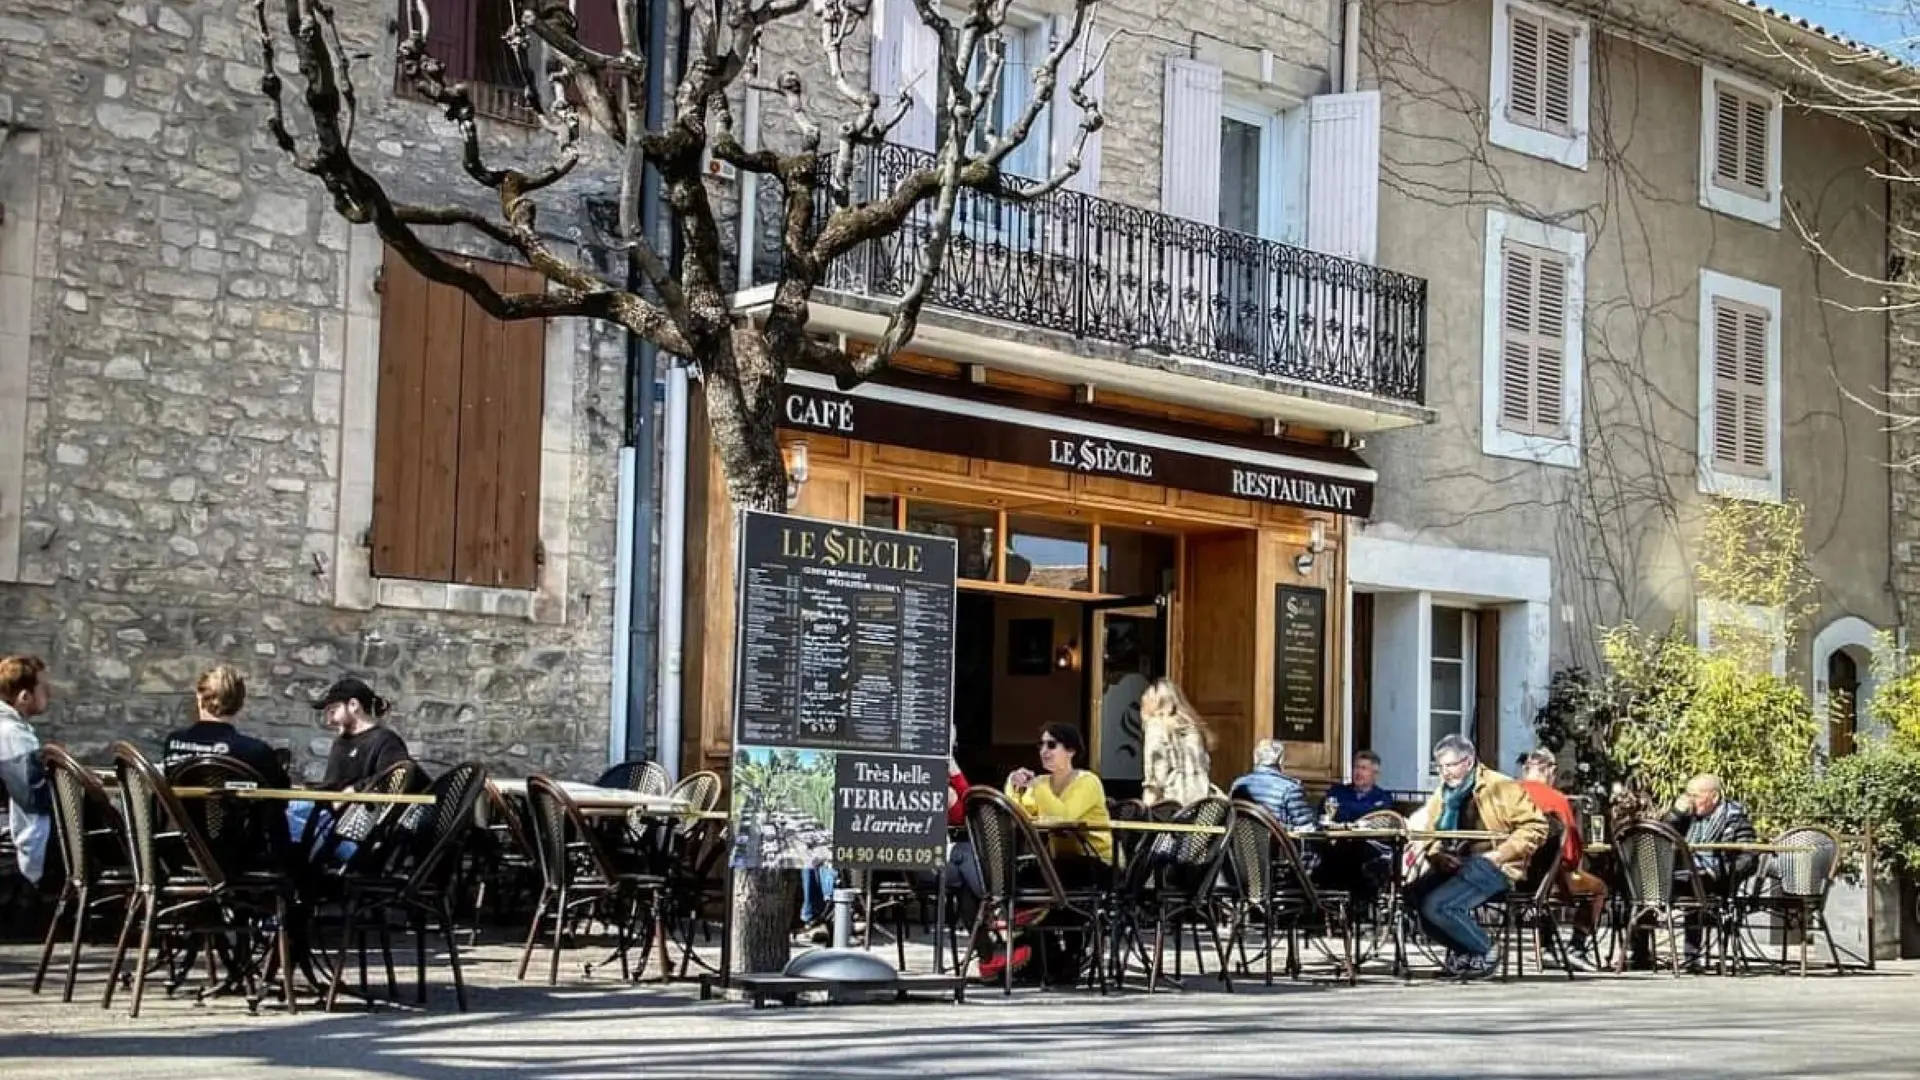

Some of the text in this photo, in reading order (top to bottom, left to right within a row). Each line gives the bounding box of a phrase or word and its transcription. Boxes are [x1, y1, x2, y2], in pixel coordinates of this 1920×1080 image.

[786, 395, 854, 431] CAFÉ
[1050, 439, 1153, 477] LE SIÈCLE
[1232, 469, 1356, 510] RESTAURANT
[782, 527, 923, 573] LE SIÈCLE
[854, 762, 931, 784] Très belle
[839, 787, 944, 812] TERRASSE
[837, 846, 933, 863] 04 90 40 63 09
